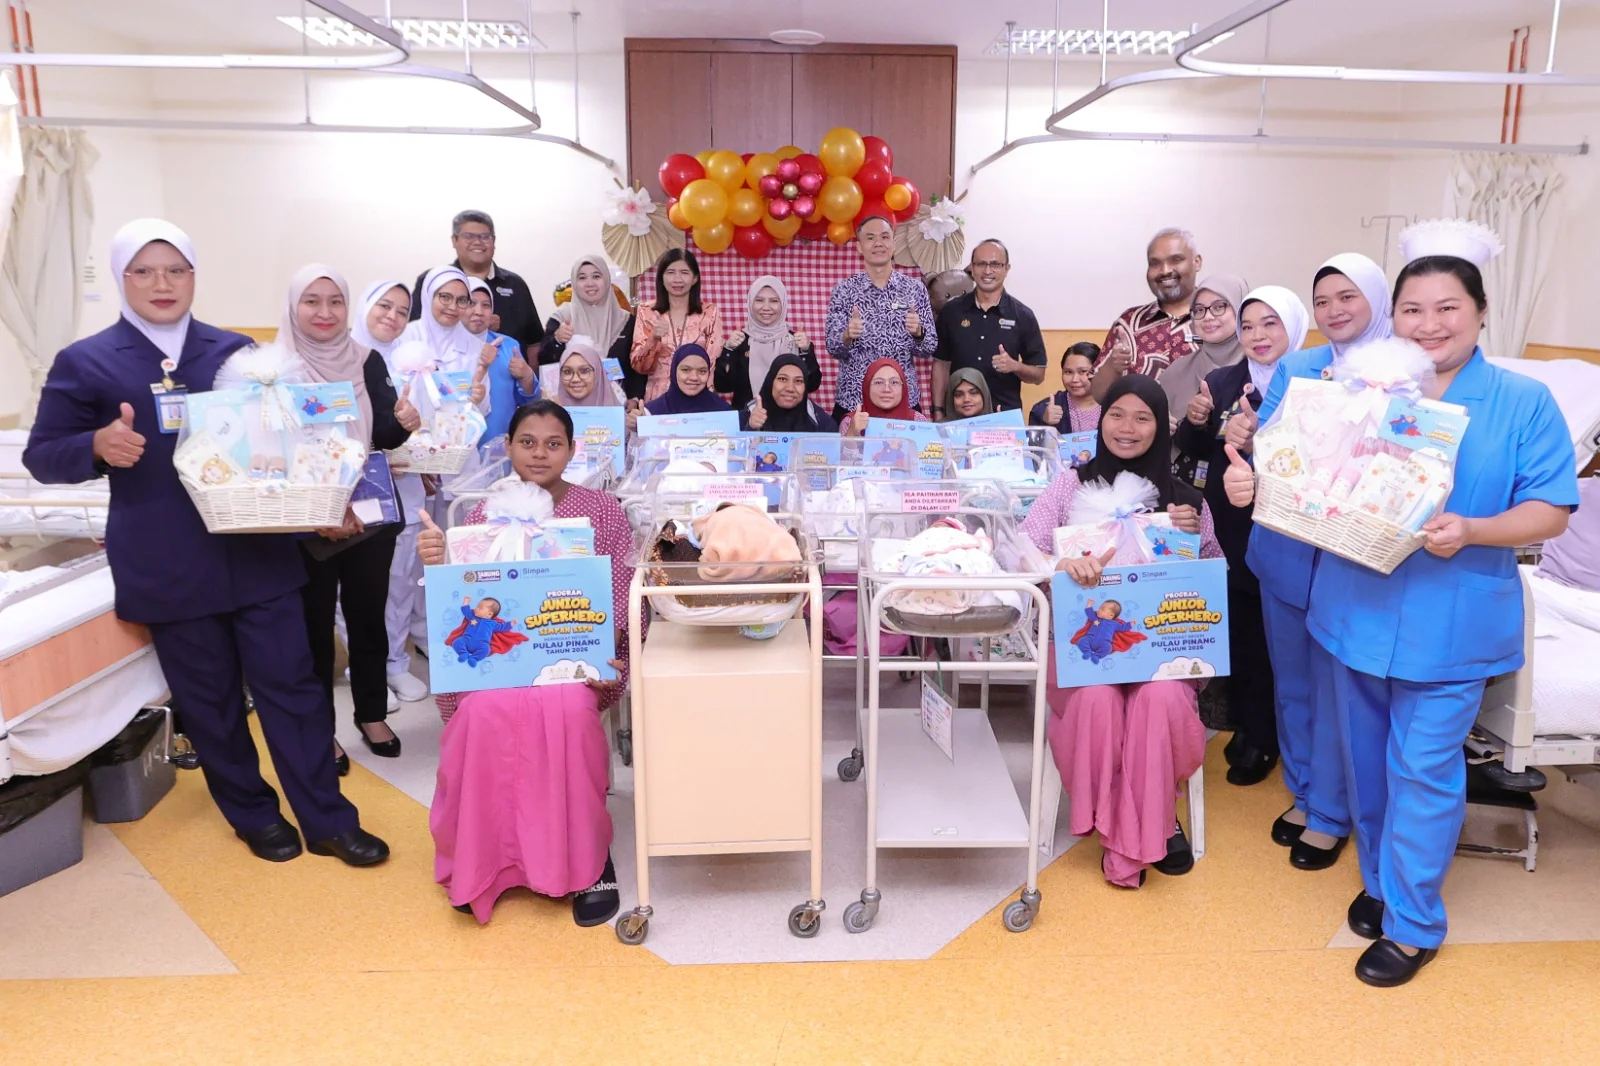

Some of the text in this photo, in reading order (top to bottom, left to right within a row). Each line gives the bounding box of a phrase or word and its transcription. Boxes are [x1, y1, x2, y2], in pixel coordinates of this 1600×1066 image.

[522, 567, 550, 575] Simpan
[546, 589, 583, 599] PROGRAM
[1164, 591, 1200, 600] PROGRAM
[540, 597, 591, 613] JUNIOR
[1157, 598, 1207, 613] JUNIOR
[525, 610, 607, 630] SUPERHERO
[1143, 610, 1222, 630] SUPERHERO
[538, 626, 571, 636] SIMPAN
[1156, 626, 1187, 636] SIMPAN
[533, 638, 601, 650] PULAU PINANG
[1151, 637, 1216, 648] PULAU PINANG
